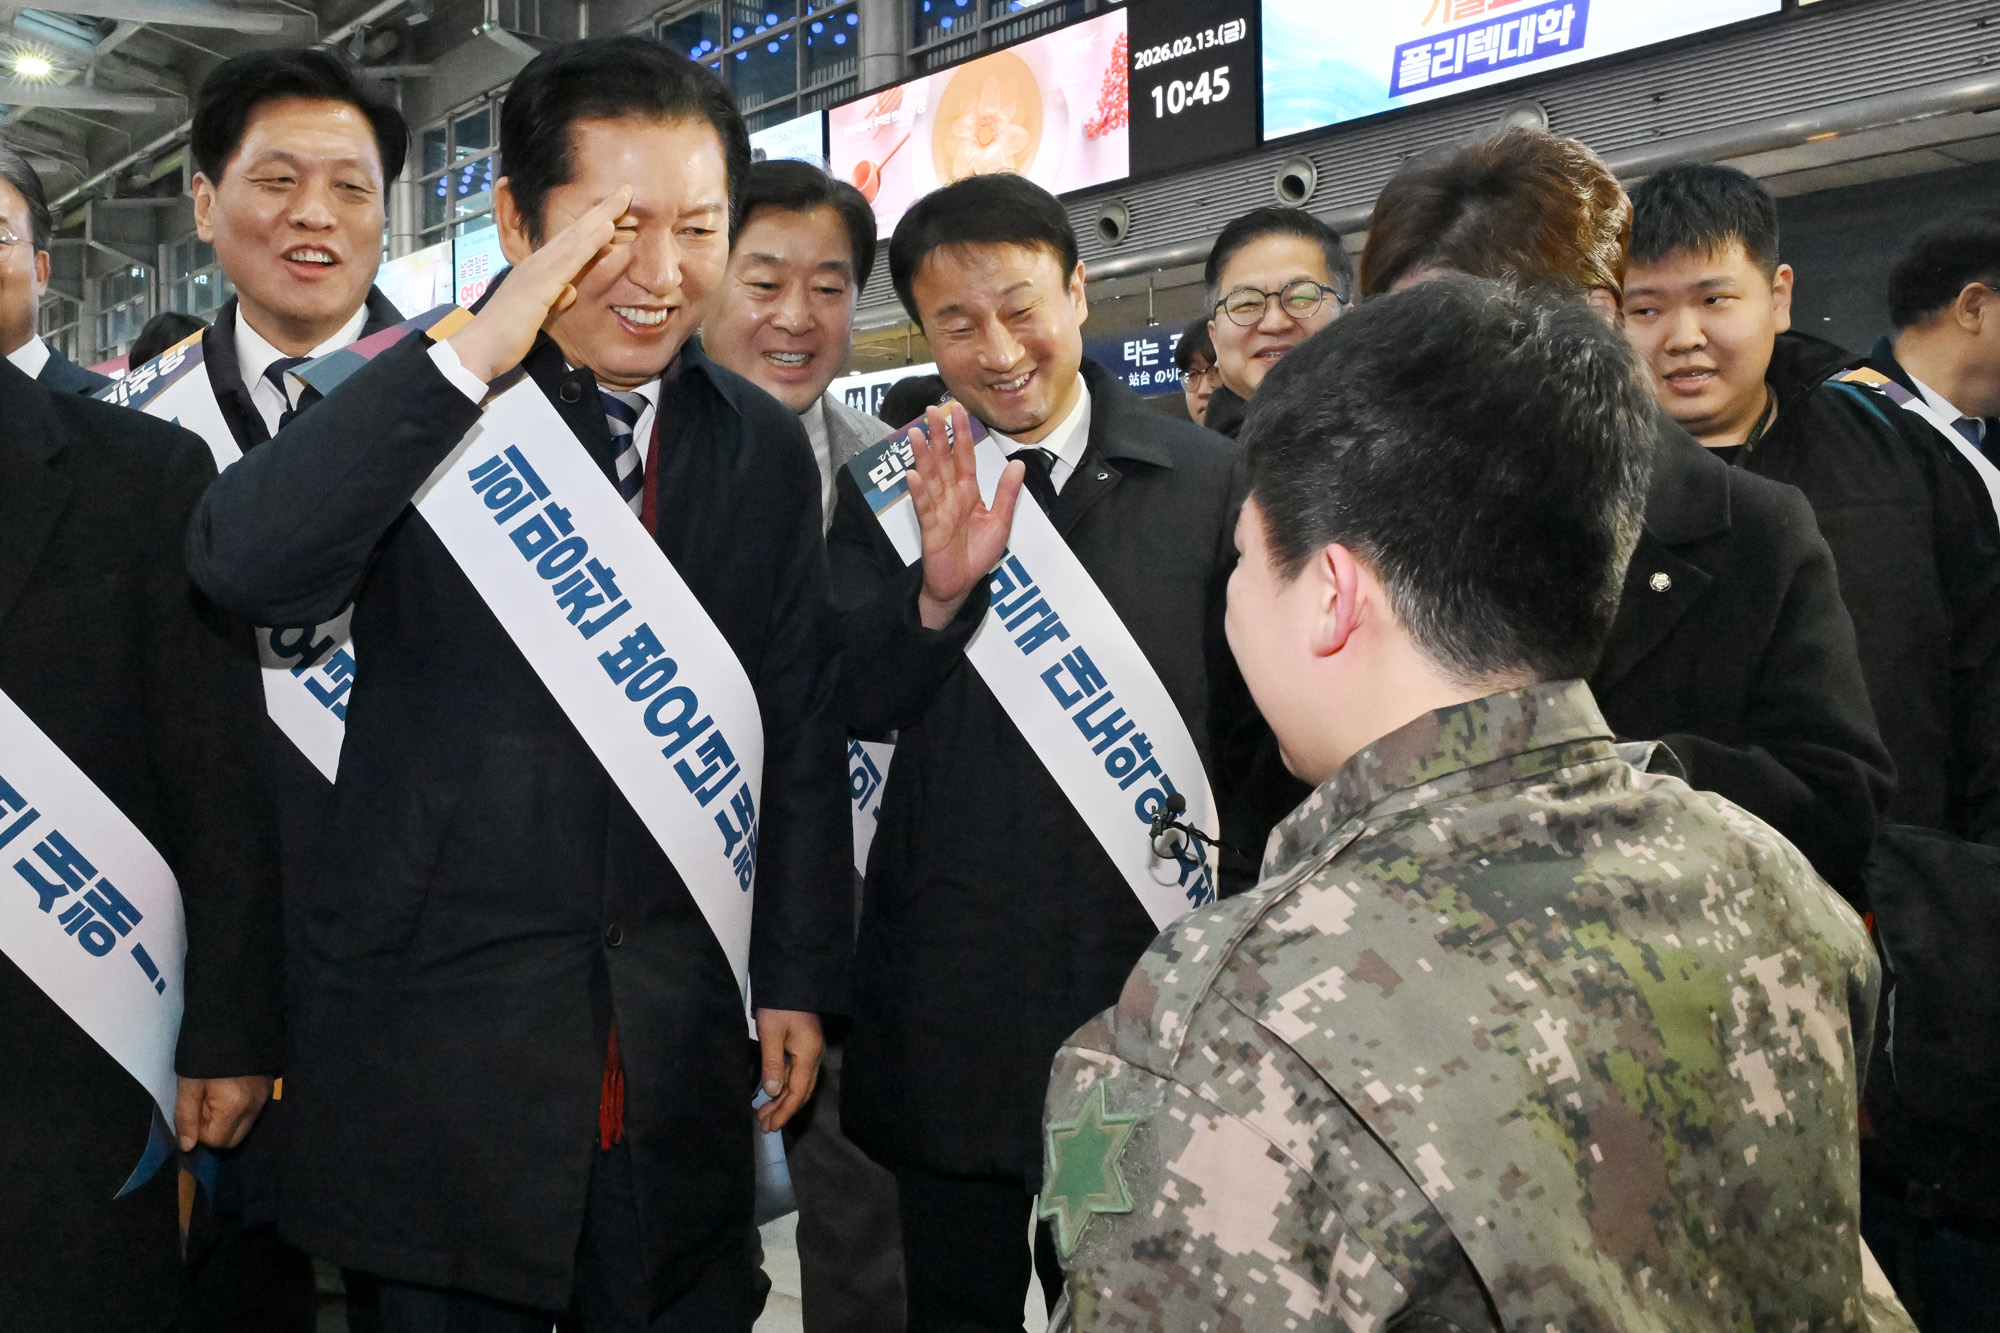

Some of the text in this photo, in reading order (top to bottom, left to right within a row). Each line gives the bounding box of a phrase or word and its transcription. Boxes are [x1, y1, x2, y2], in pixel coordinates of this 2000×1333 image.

[1421, 0, 1523, 27] 기술
[1134, 18, 1246, 70] 2026.02.13.(금)
[1398, 3, 1576, 89] 폴리텍대학
[1151, 65, 1230, 118] 10:45
[1123, 339, 1160, 367] 타는
[1128, 370, 1151, 387] 站台
[467, 444, 632, 640] 희망찬
[597, 622, 740, 808] 병오년
[989, 546, 1071, 656] 민국
[13, 829, 167, 996] 새해!
